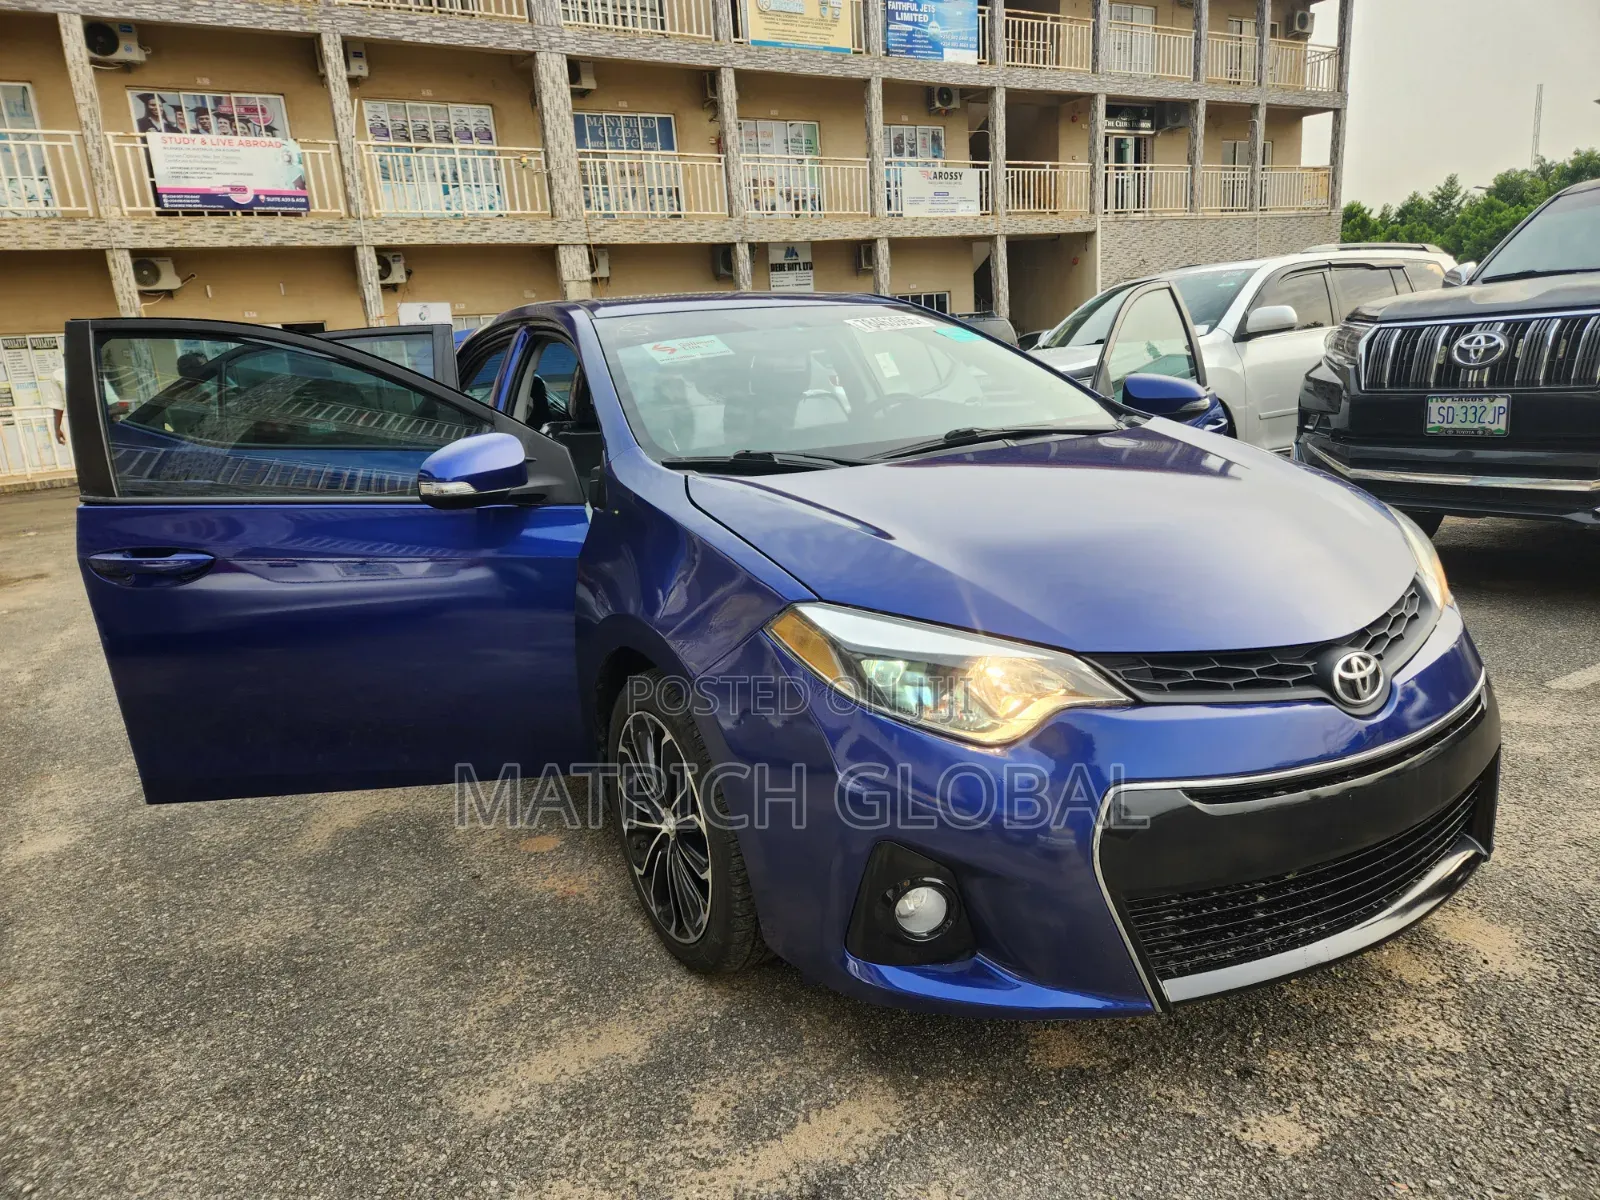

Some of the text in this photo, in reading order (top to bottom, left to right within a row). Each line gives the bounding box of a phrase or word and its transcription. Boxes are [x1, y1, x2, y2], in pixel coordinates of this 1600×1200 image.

[887, 1, 936, 13] FAITHFUL JETS
[895, 12, 929, 22] LIMITED
[161, 136, 282, 149] STUDY & LIVE ABROAD
